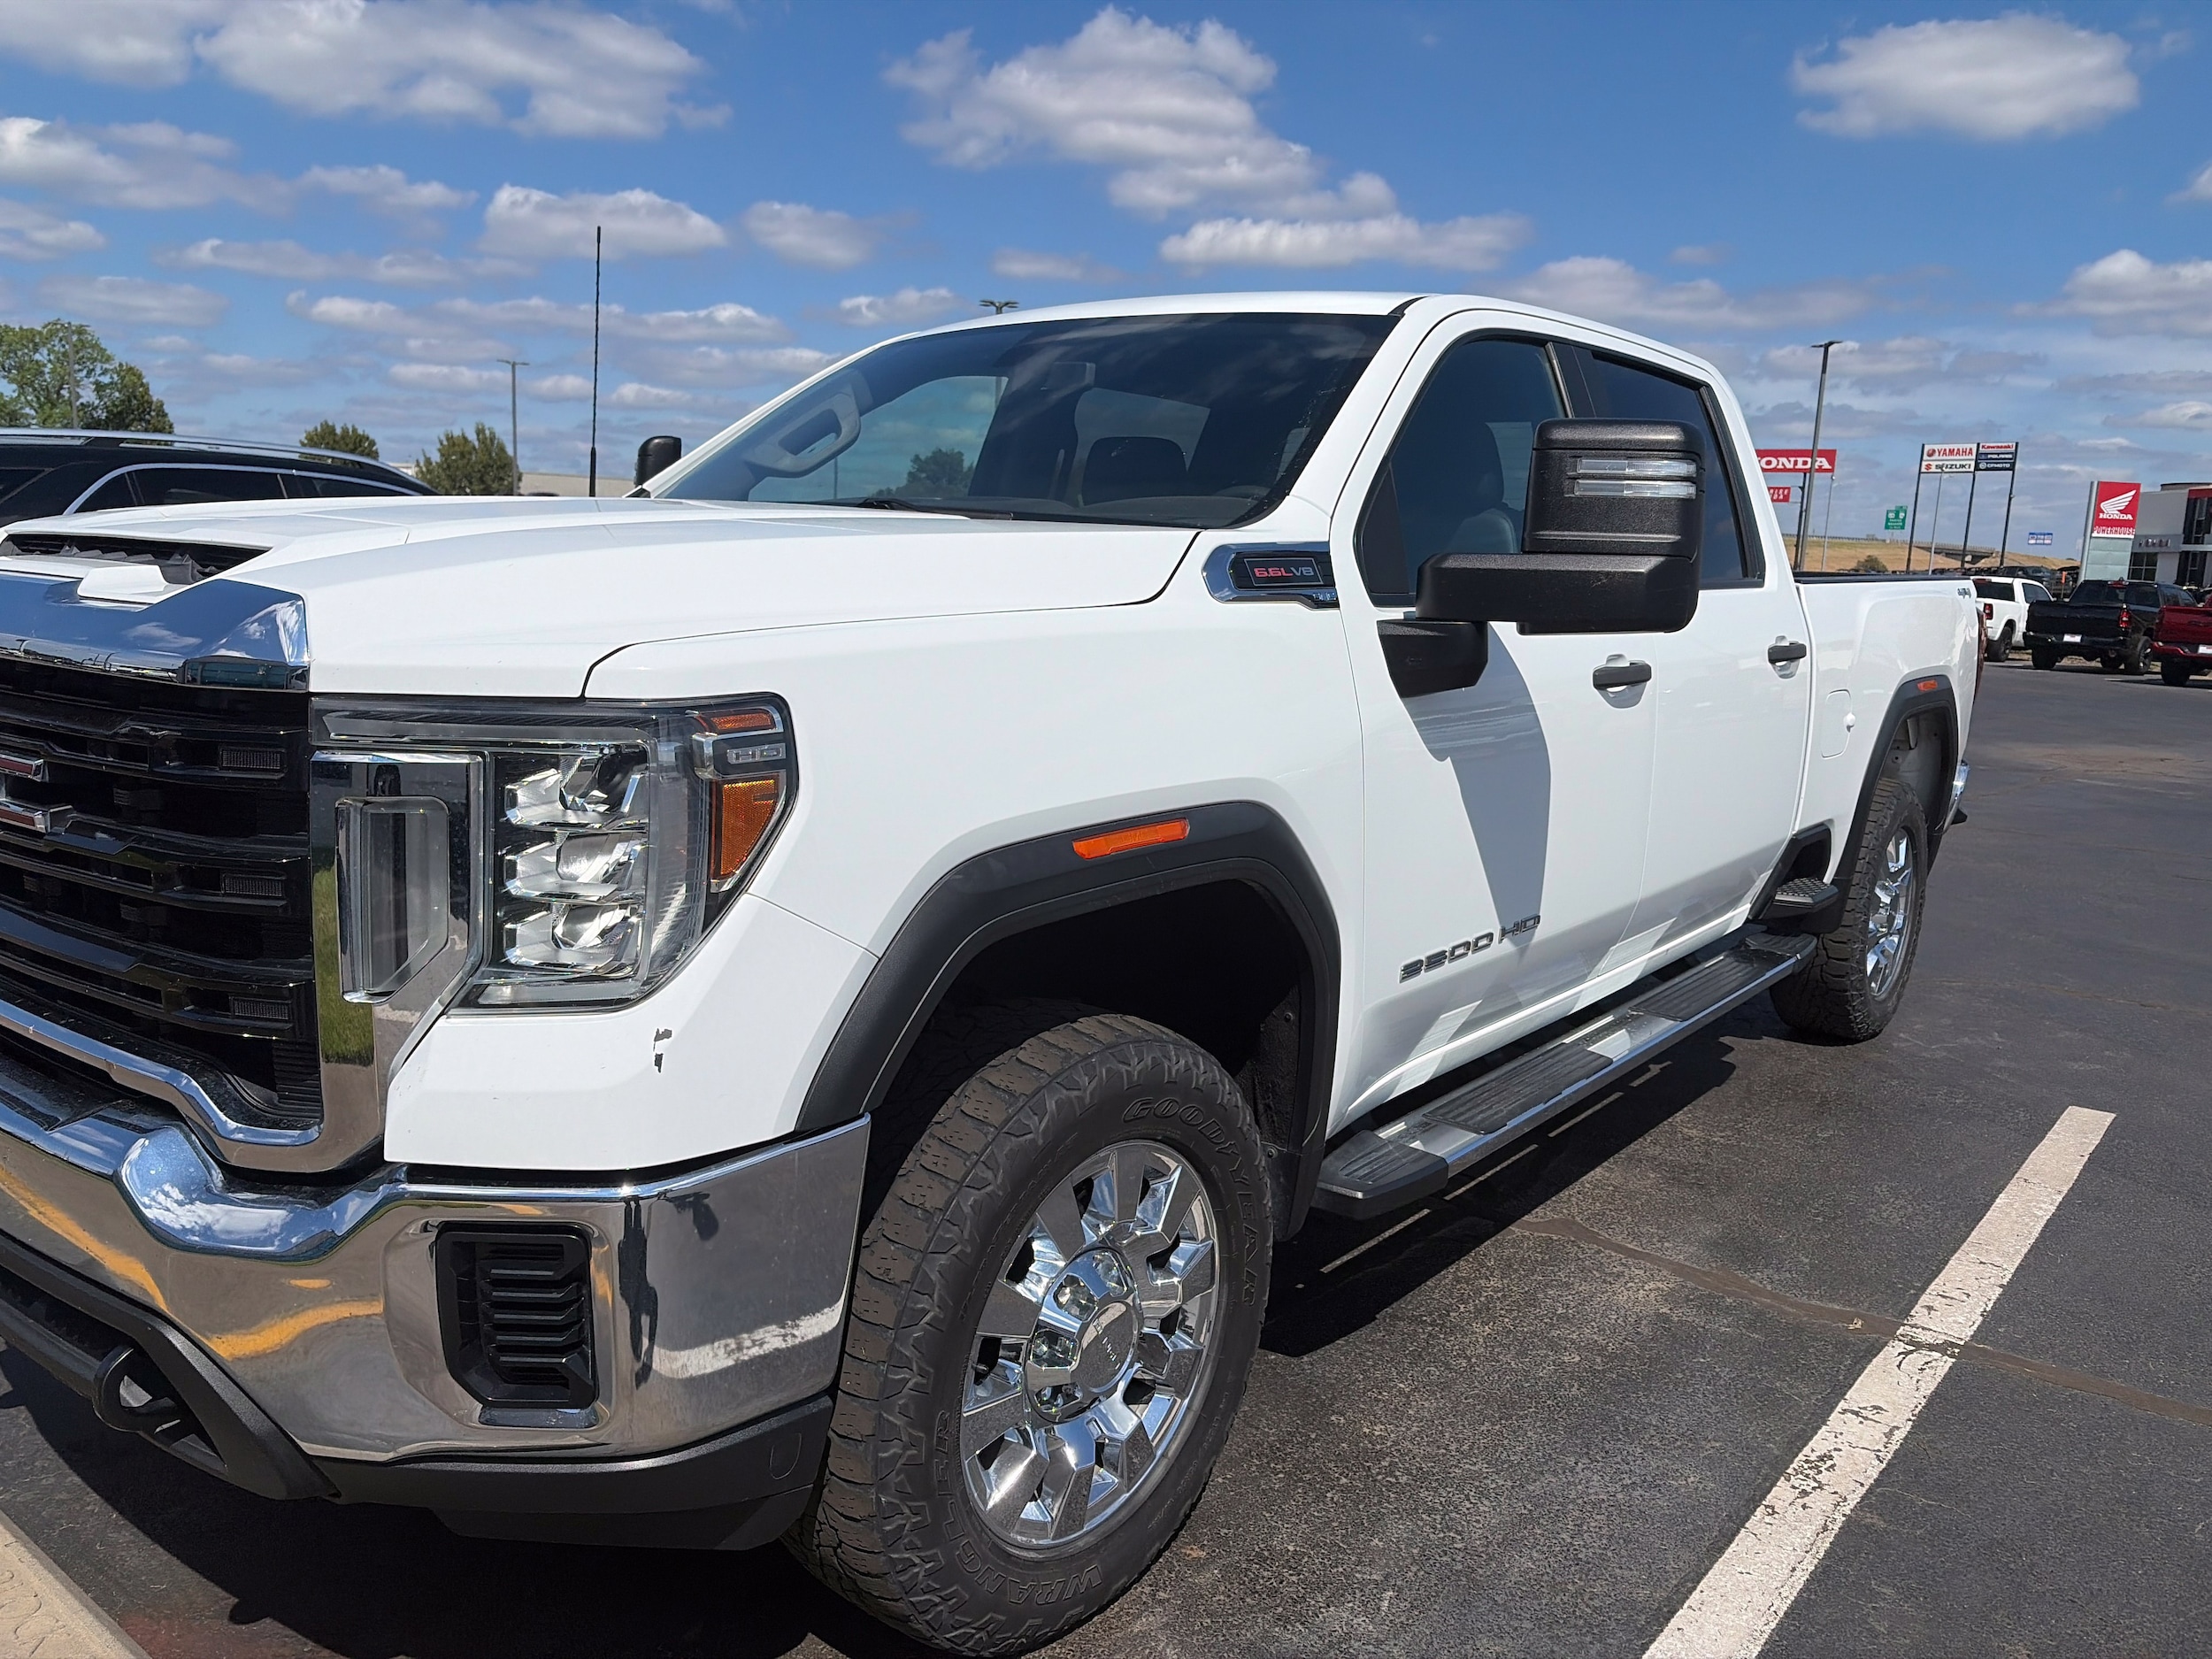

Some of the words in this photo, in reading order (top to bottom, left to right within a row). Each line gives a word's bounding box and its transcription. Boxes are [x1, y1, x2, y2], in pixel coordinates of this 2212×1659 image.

[1937, 447, 1973, 457] YAMAHA
[1758, 457, 1832, 469] ONDA
[2093, 526, 2135, 536] POWERHOUSE
[1497, 914, 1541, 945] HD
[1122, 1096, 1259, 1307] GOODYEAR
[933, 1410, 1103, 1605] WRANGLER
